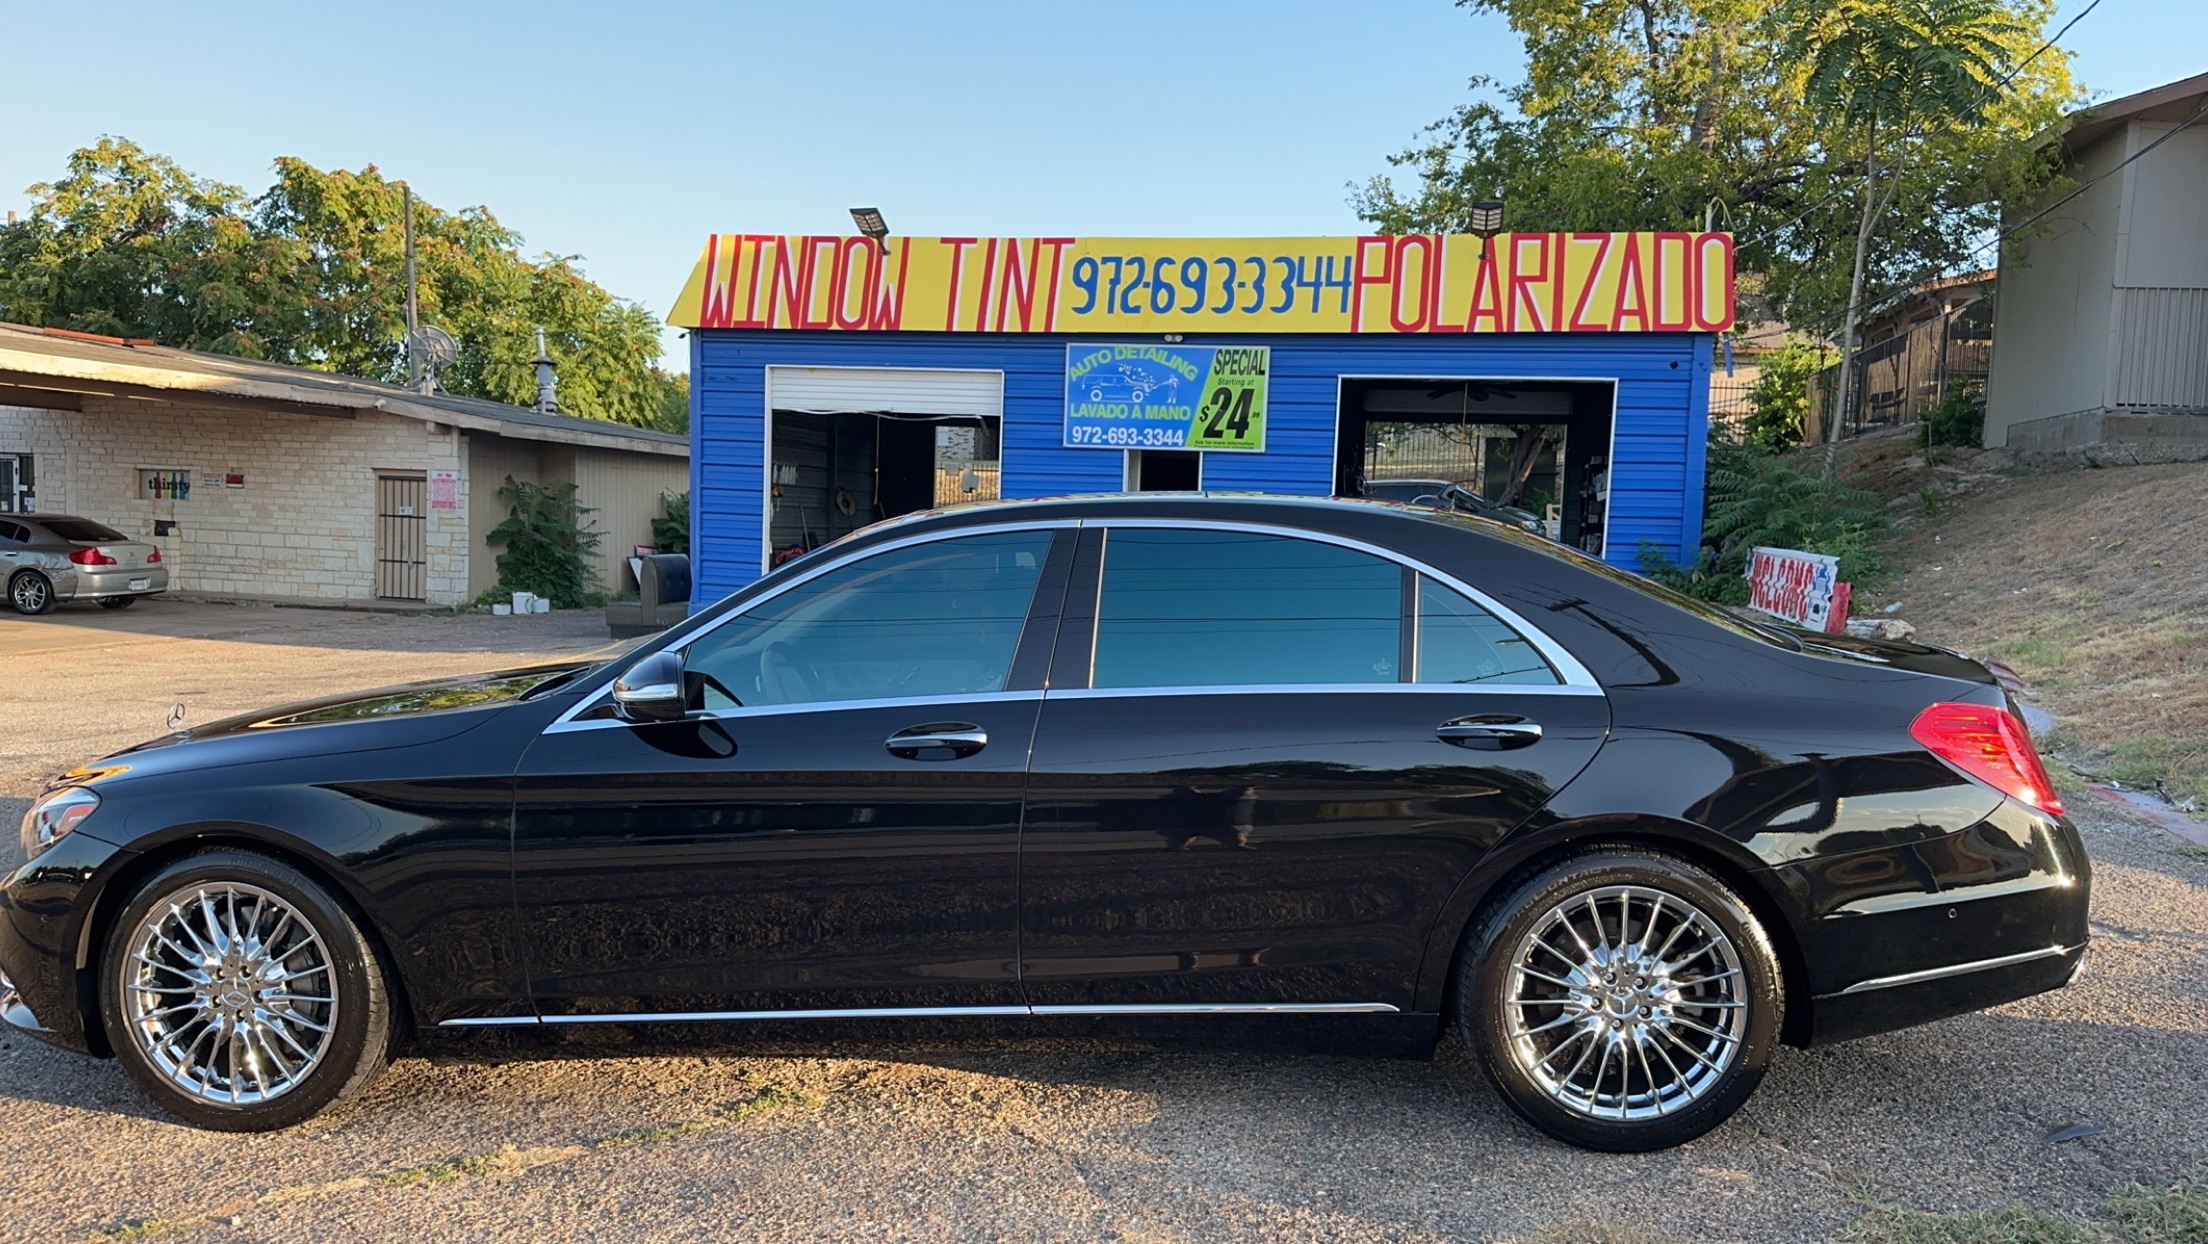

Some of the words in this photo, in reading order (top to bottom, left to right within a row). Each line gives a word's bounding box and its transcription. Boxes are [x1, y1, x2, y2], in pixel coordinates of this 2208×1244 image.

[700, 234, 910, 332] WINDOW
[940, 237, 1076, 332] TINT
[1071, 256, 1352, 314] 972-693-3344
[1351, 232, 1734, 333] POLARIZADO
[1069, 349, 1112, 382] AUTO
[1114, 346, 1199, 382] DETAILING
[1214, 349, 1266, 376] SPECIAL
[1217, 377, 1245, 388] Starting
[1070, 403, 1129, 419] LAVADO
[1131, 405, 1143, 419] A
[1145, 405, 1192, 421] MANO
[1072, 425, 1184, 446] 972-693-3344
[148, 478, 190, 493] thirsty
